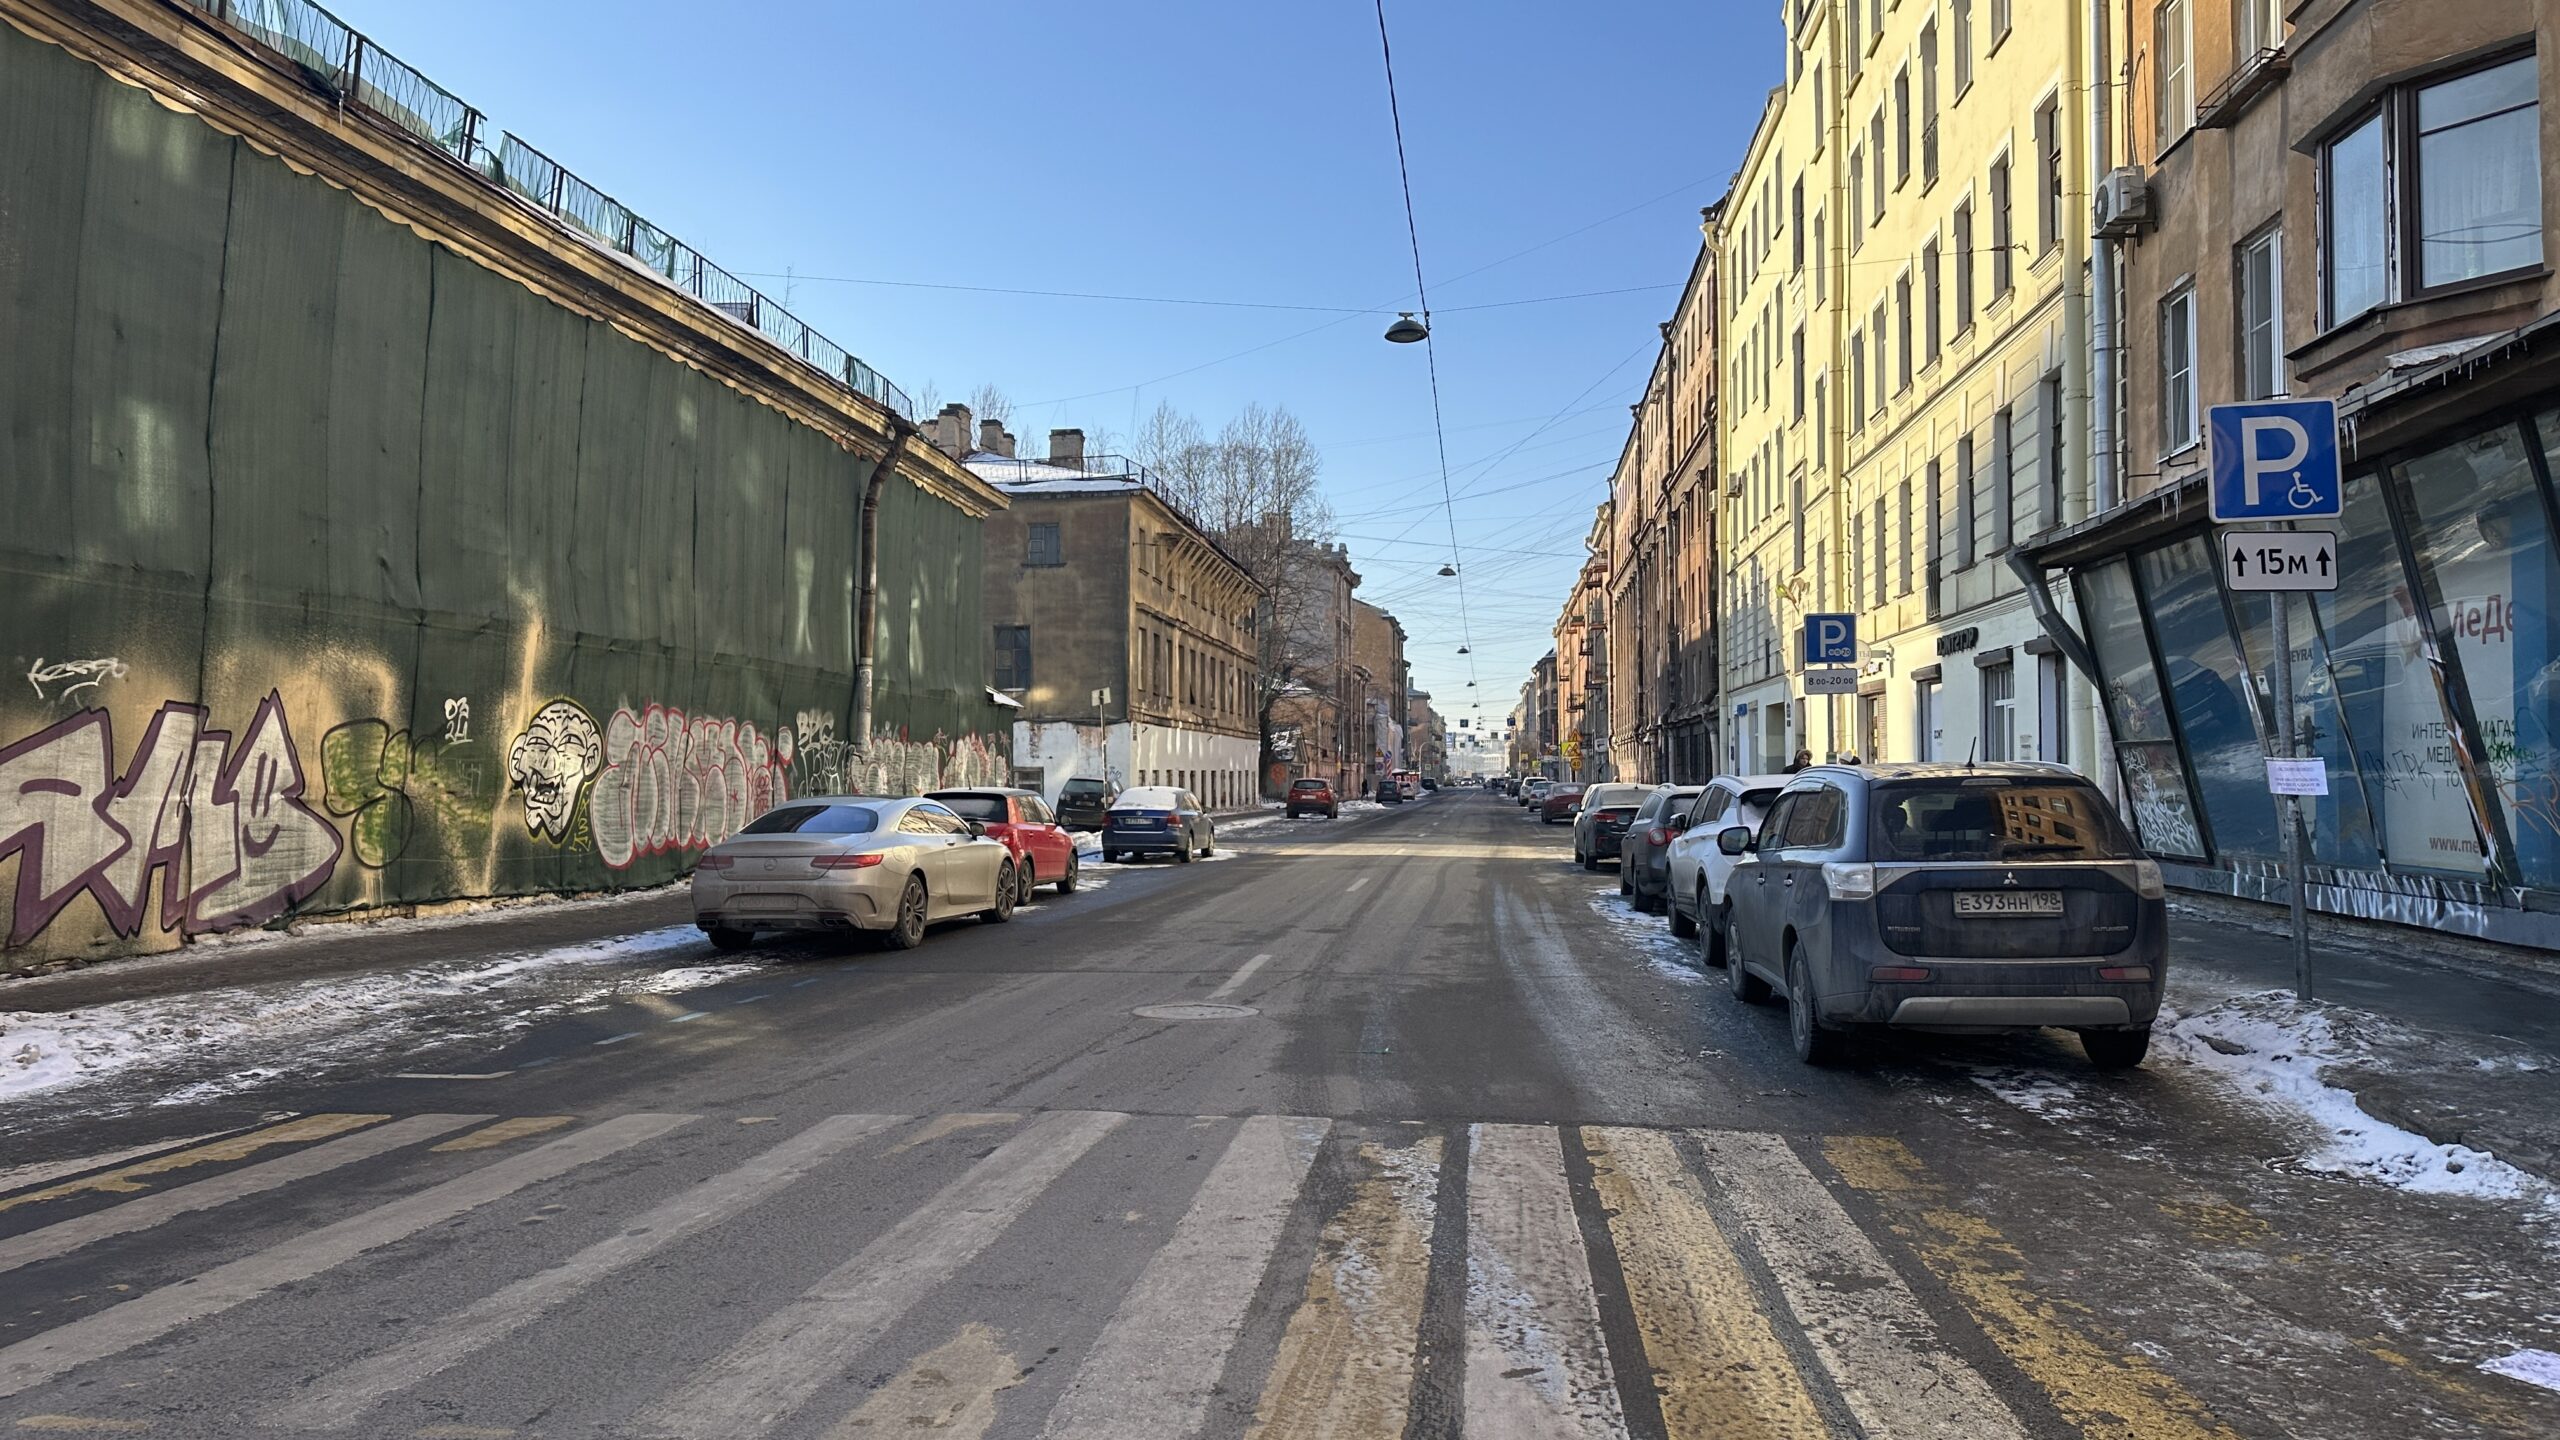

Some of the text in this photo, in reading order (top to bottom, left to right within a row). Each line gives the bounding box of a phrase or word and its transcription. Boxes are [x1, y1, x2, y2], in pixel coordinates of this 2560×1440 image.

[2241, 416, 2309, 506] P
[1819, 619, 1847, 658] P
[2290, 648, 2313, 663] EYRA
